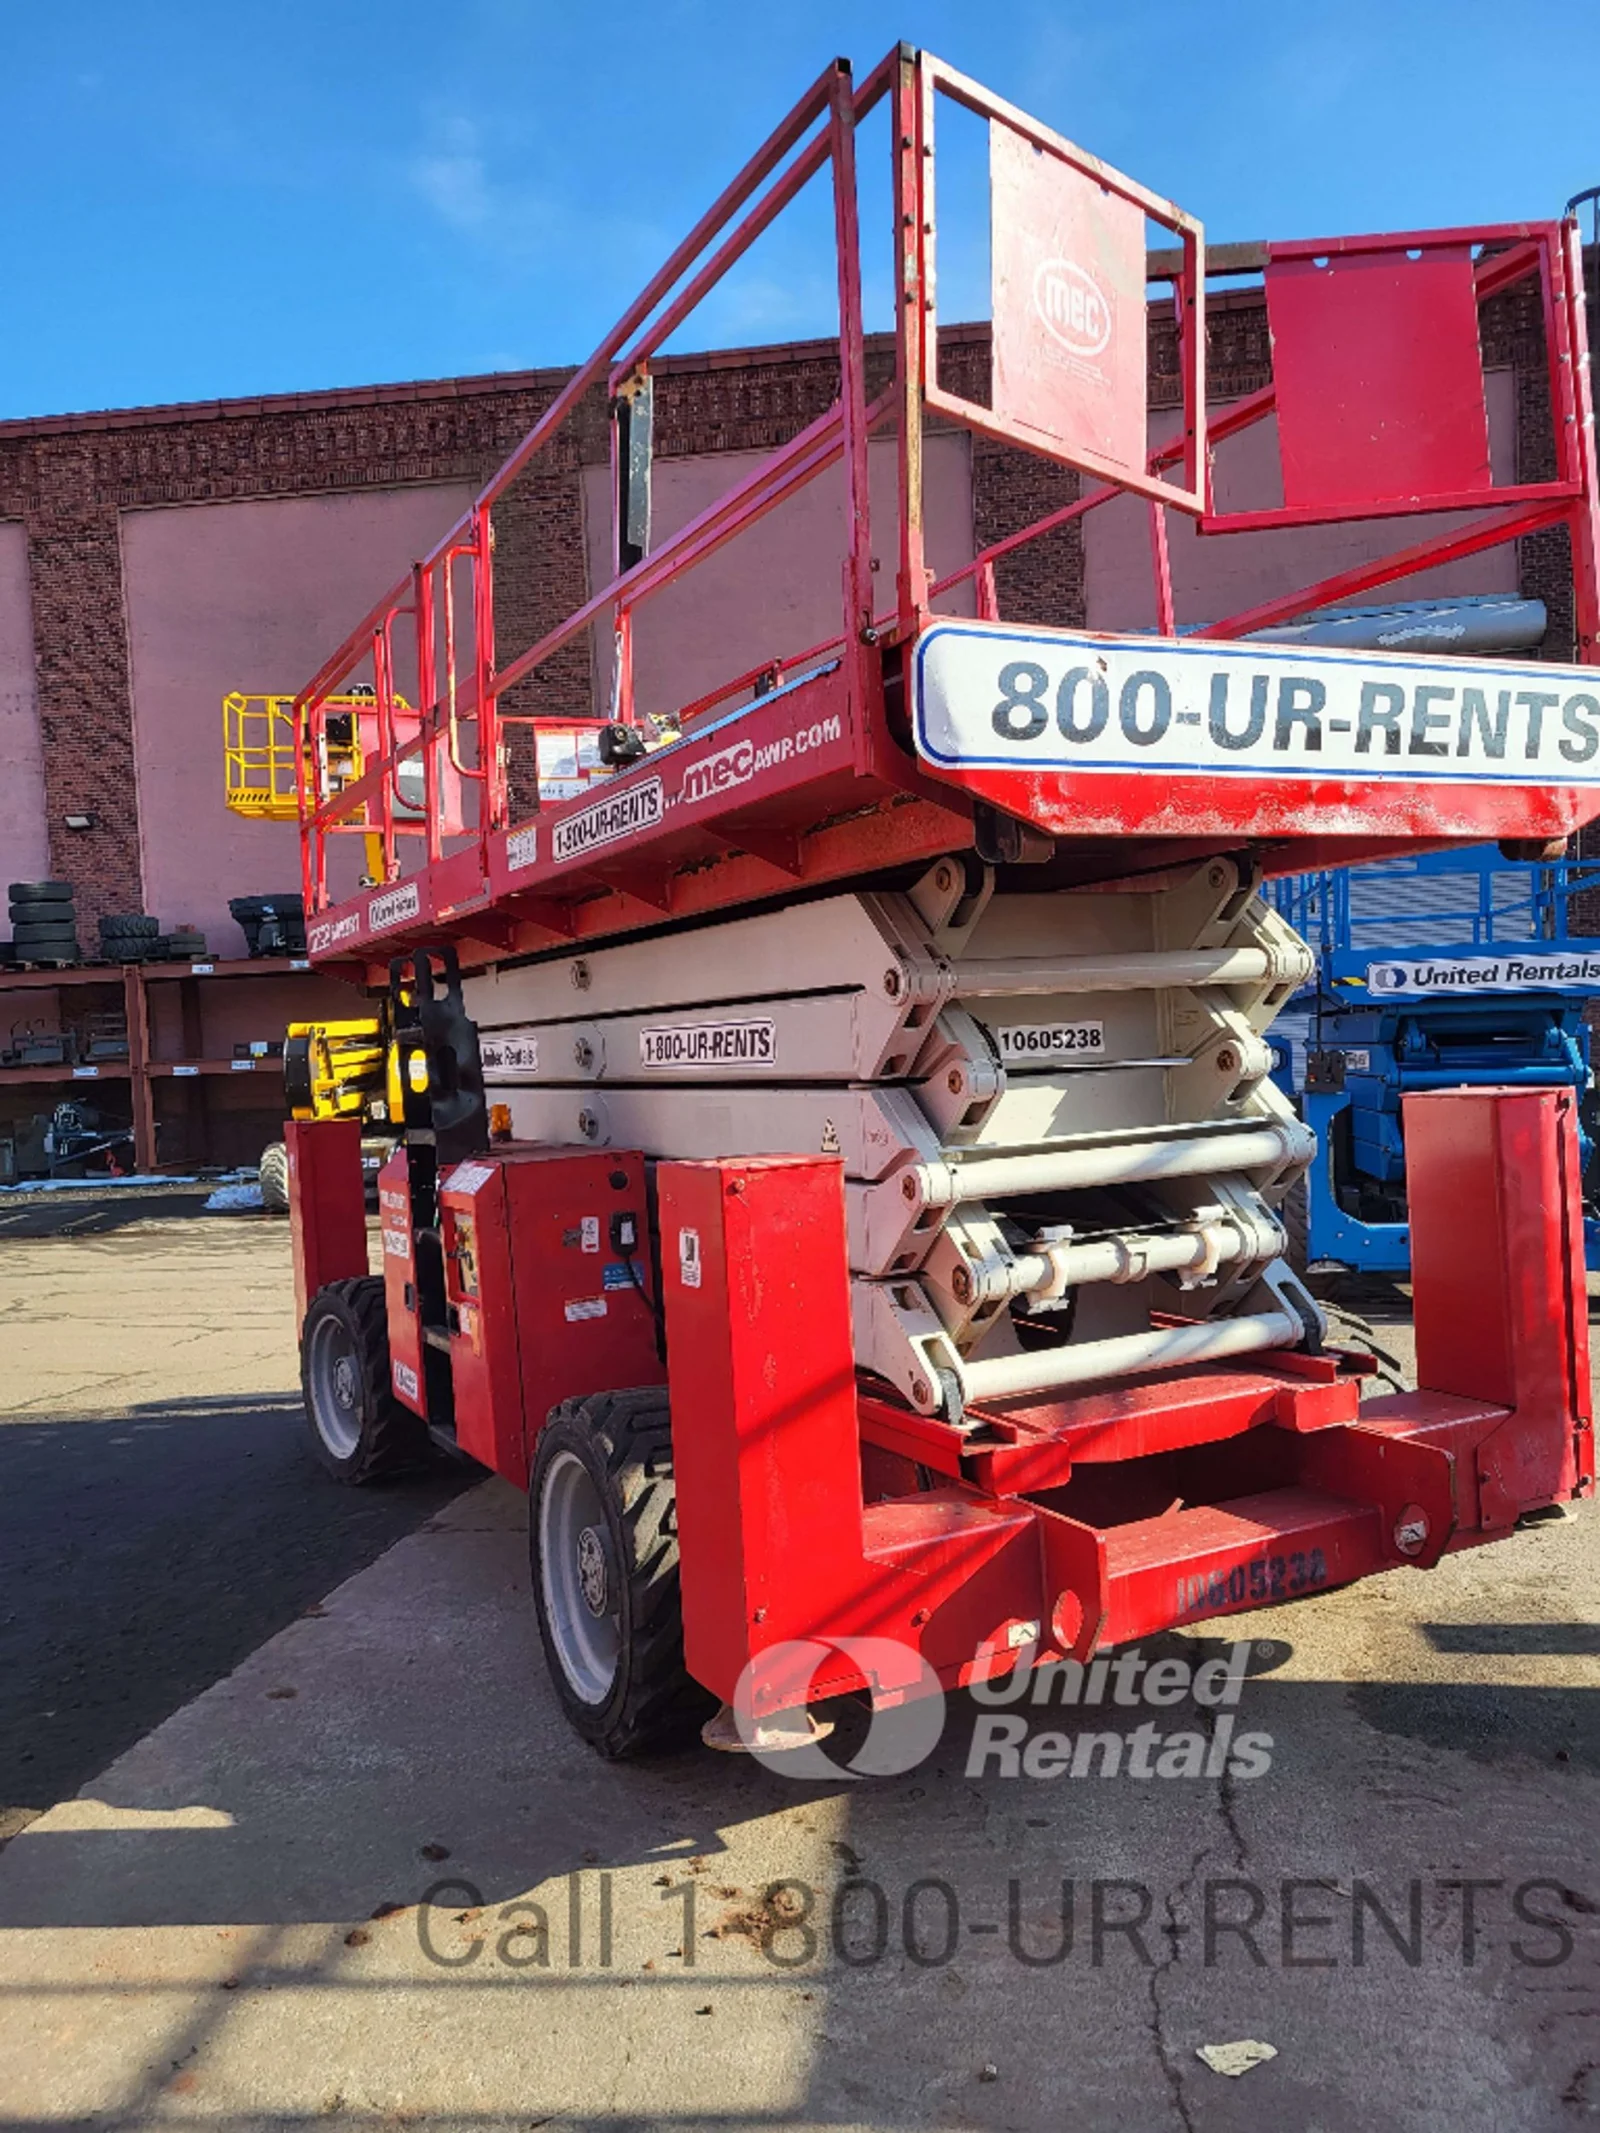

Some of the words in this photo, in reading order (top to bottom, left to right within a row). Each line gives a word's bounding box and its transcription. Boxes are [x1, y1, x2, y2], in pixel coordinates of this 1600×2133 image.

[1413, 964, 1499, 988] United
[1505, 959, 1600, 983] Rentals
[645, 1027, 770, 1061] 1-800-UR-RENTS
[1001, 1028, 1102, 1051] 10605238
